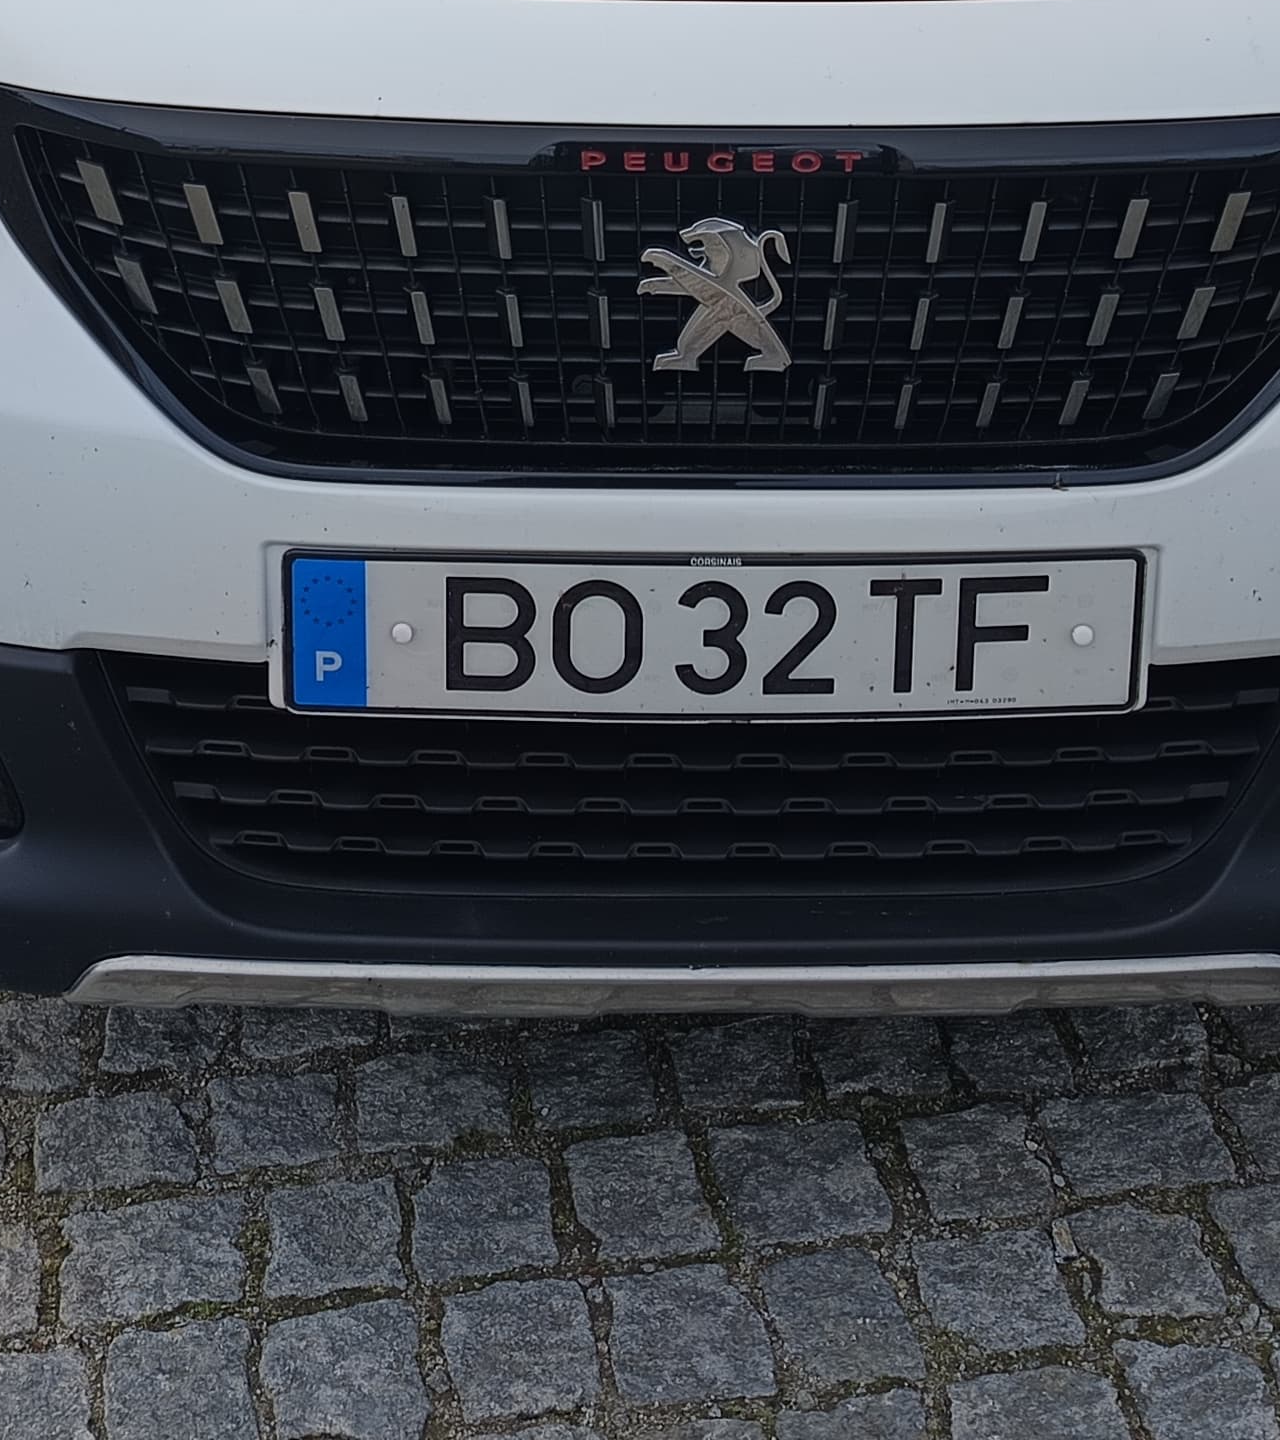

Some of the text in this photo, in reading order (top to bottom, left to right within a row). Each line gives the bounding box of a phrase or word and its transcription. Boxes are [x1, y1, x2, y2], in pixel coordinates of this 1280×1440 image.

[580, 150, 864, 173] PEUGEOT
[445, 574, 1051, 696] BO 32 TF
[315, 650, 343, 682] P
